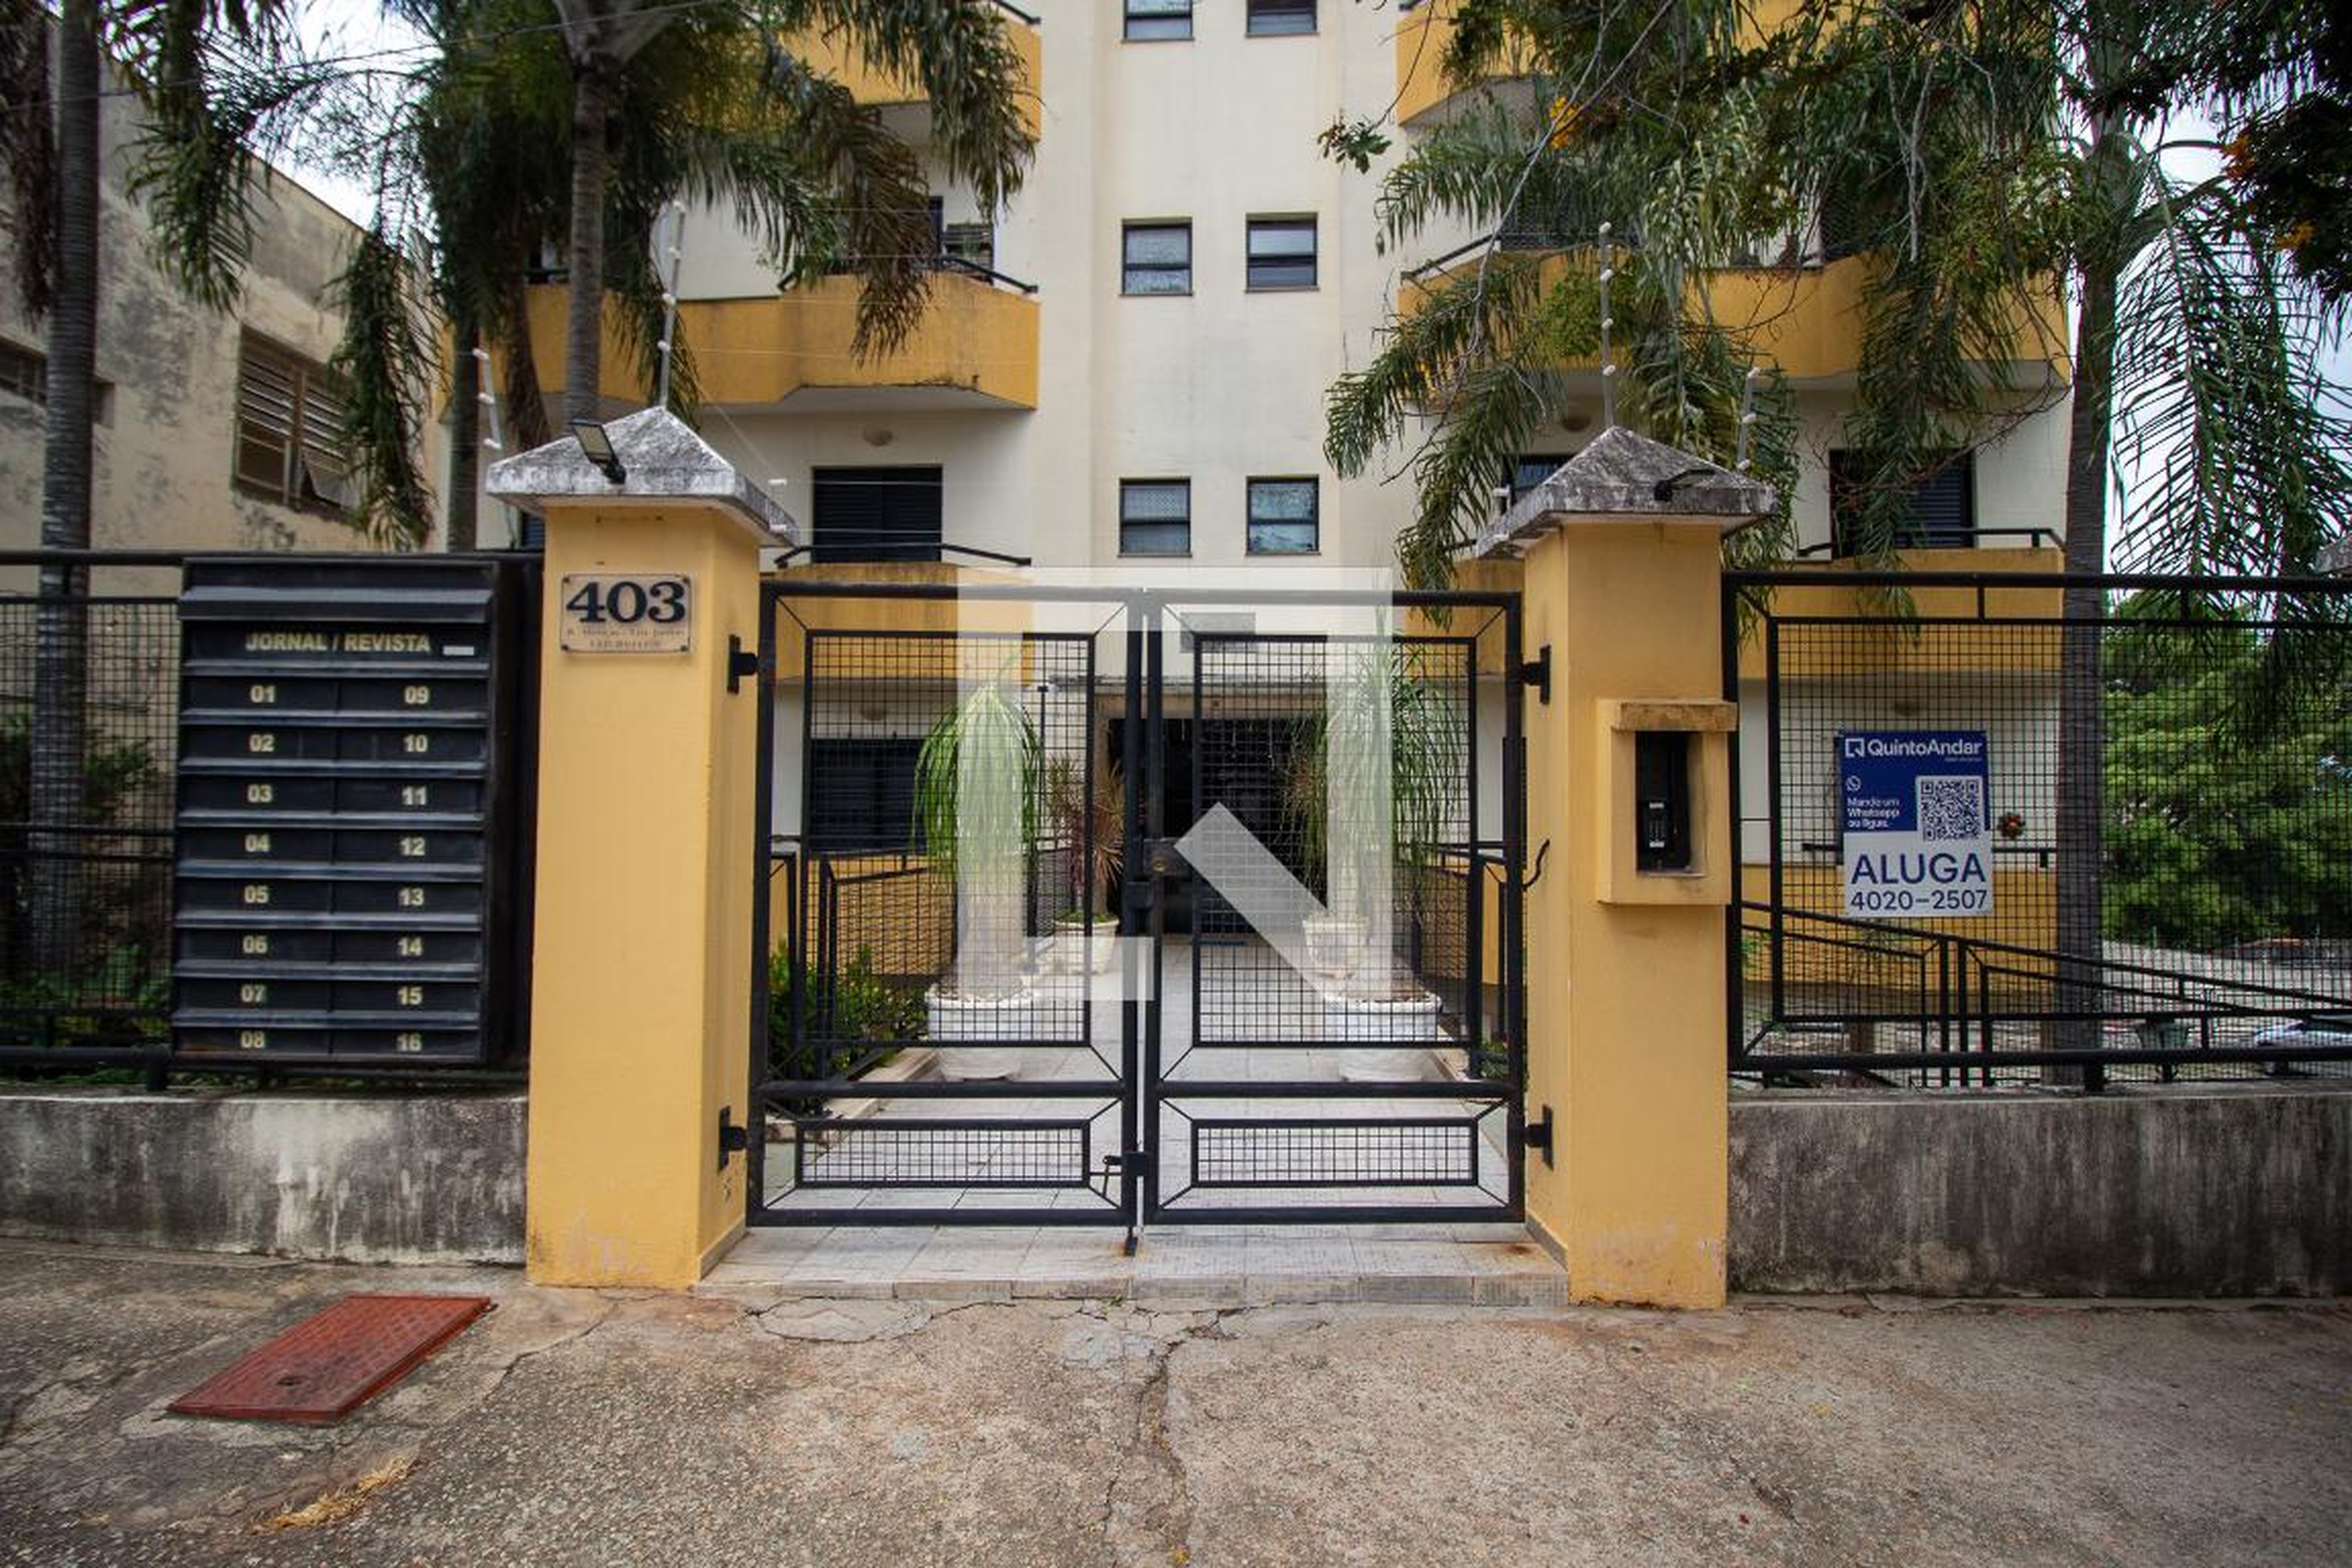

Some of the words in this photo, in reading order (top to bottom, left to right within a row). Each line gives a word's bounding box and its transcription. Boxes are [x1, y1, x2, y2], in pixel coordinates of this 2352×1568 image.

[565, 581, 685, 624] 403
[246, 634, 328, 651] JORNAL
[344, 635, 431, 652] REVISTA
[251, 685, 274, 703] 01
[405, 687, 429, 704] 09
[250, 734, 274, 752] 02
[404, 735, 428, 753] 10
[1867, 737, 1983, 756] QuintoAndar
[247, 785, 273, 802] 03
[402, 787, 427, 805] 11
[245, 835, 270, 852] 04
[400, 837, 425, 856] 12
[1850, 853, 1986, 884] ALUGA
[244, 886, 269, 903] 05
[399, 888, 424, 906] 13
[1850, 889, 1988, 911] 4020-2507
[243, 937, 268, 954] 06
[398, 938, 423, 956] 14
[241, 985, 266, 1003] 07
[398, 987, 423, 1005] 15
[240, 1031, 266, 1049] 08
[396, 1034, 422, 1052] 16
